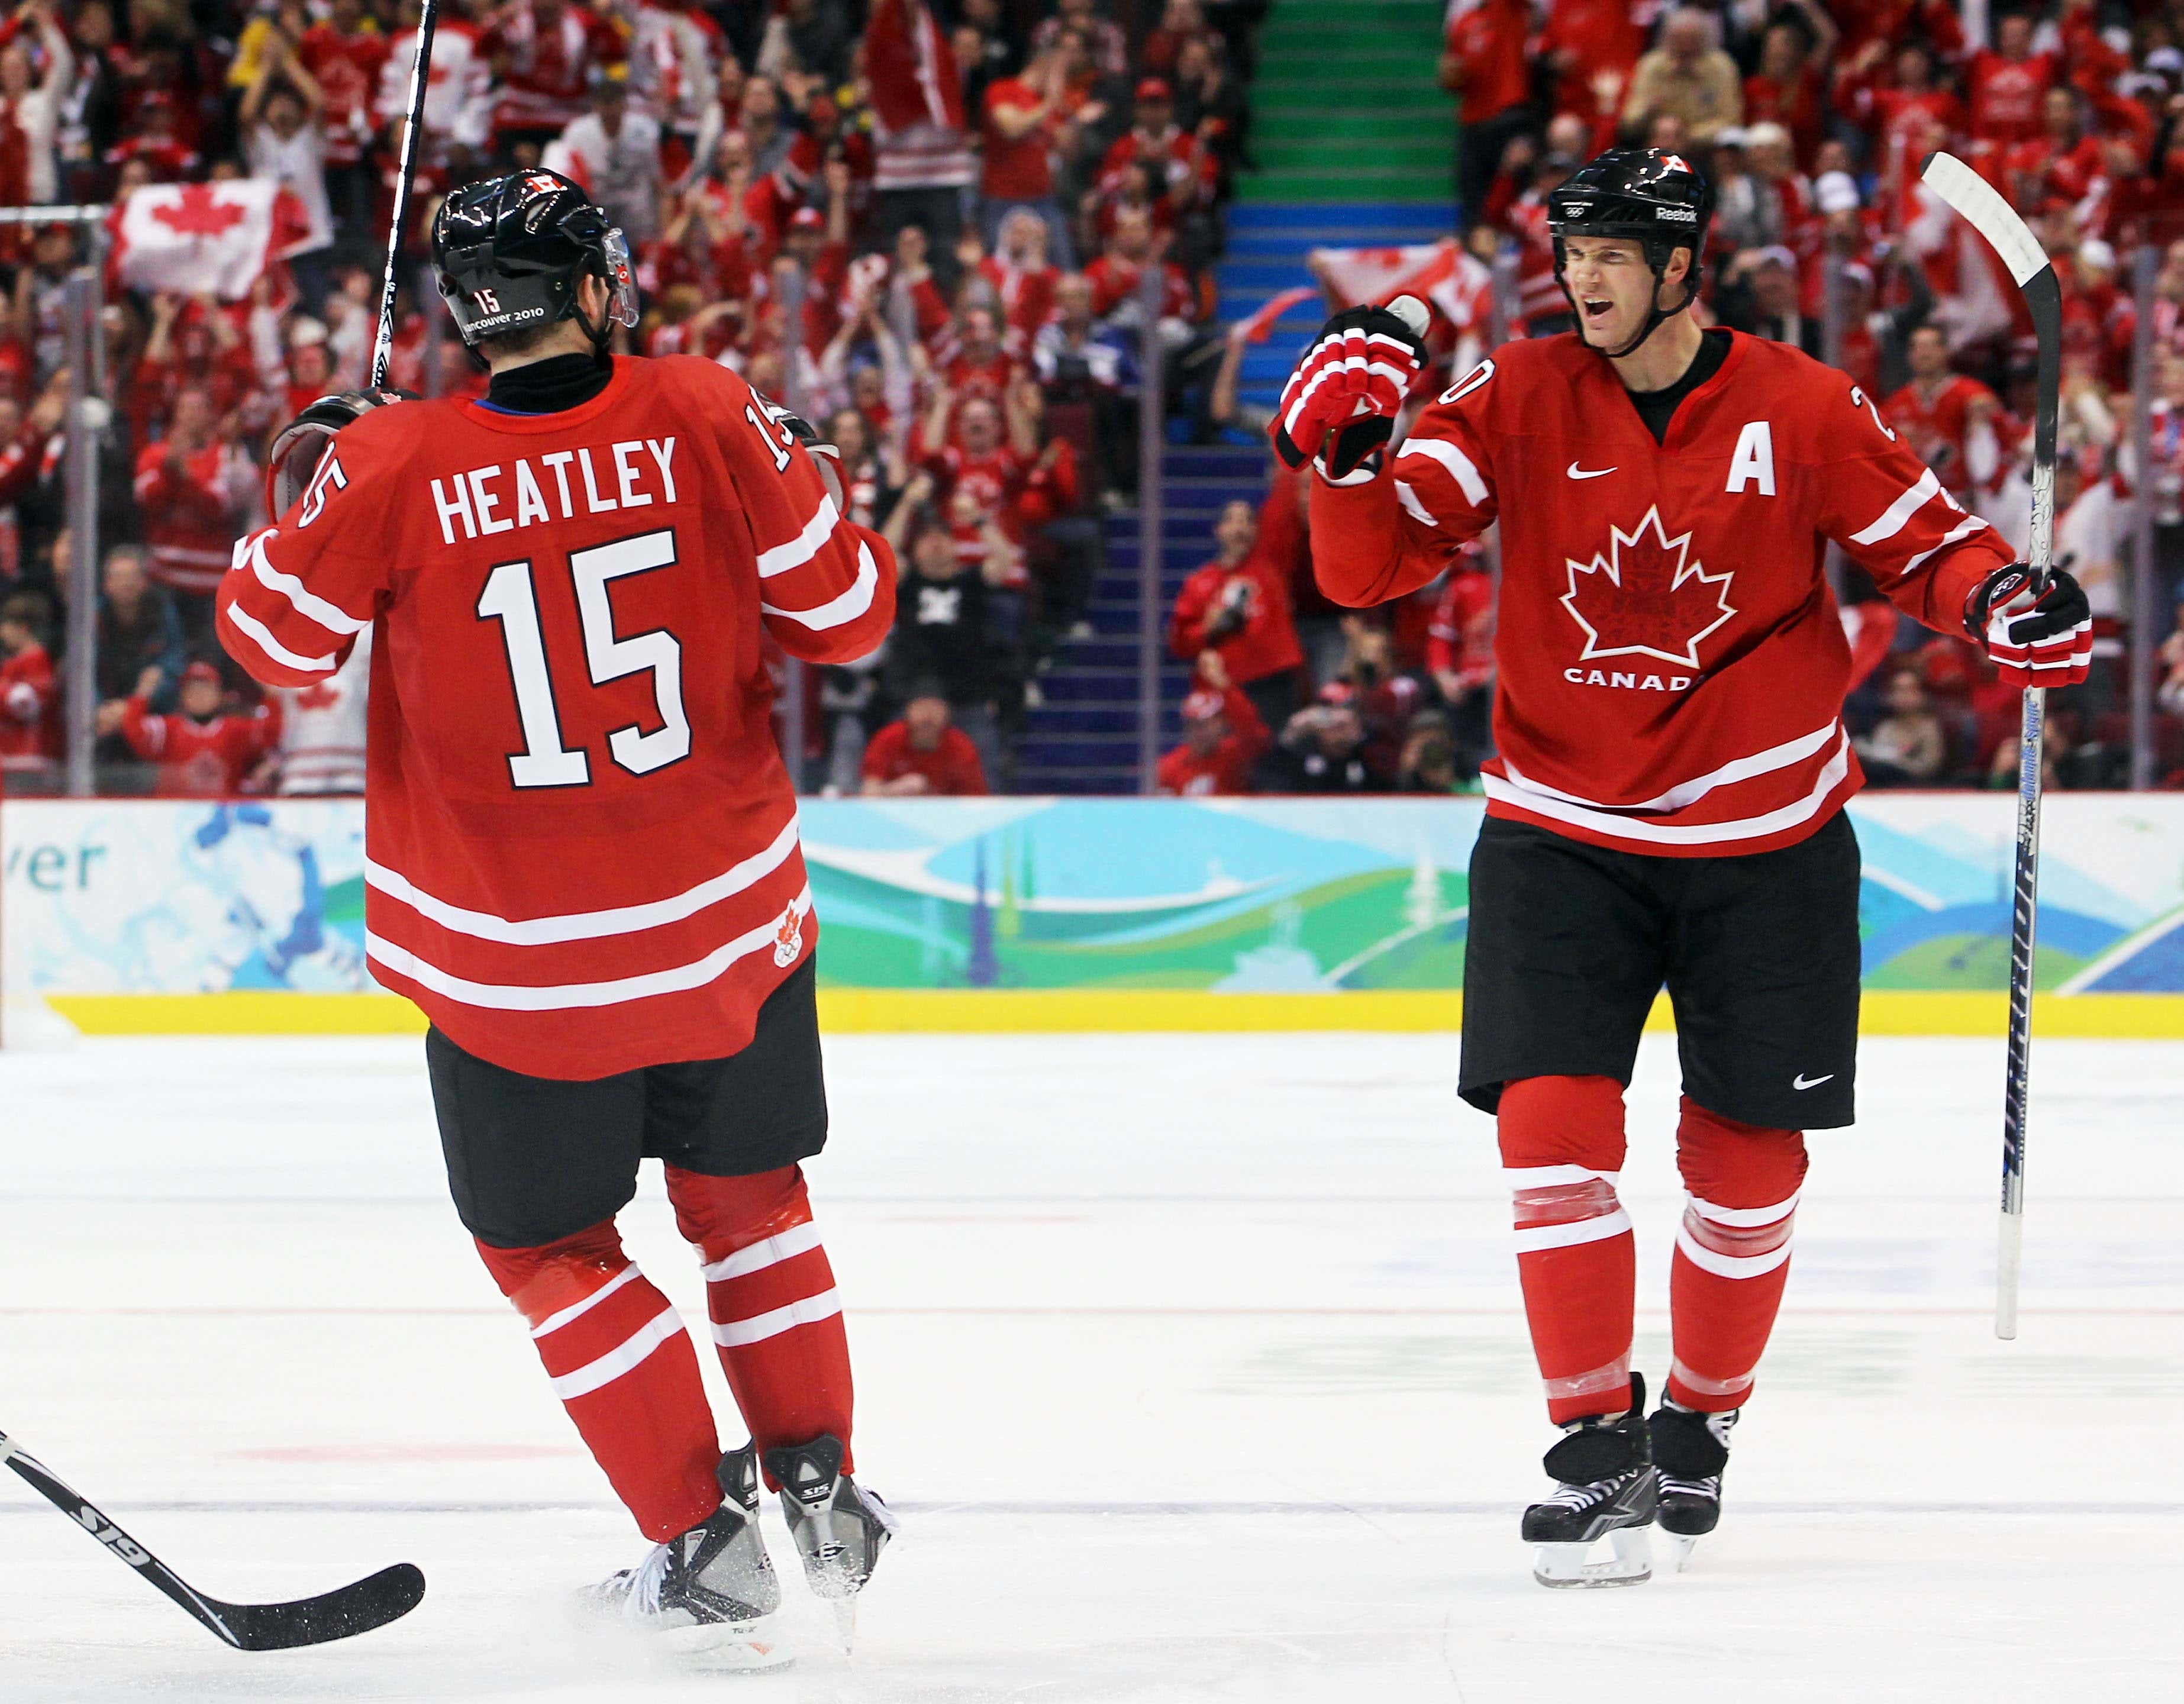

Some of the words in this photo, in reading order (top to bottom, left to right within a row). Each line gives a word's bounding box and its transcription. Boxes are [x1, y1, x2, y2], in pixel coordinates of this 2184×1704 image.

[1656, 207, 1698, 223] Reebok
[473, 288, 501, 315] 15
[514, 307, 545, 321] 2010
[297, 441, 349, 528] 15
[1725, 421, 1776, 496] A
[431, 436, 678, 545] HEATLEY
[476, 528, 691, 789] 15
[1563, 667, 1695, 692] CANAD
[69, 1505, 151, 1567] S19
